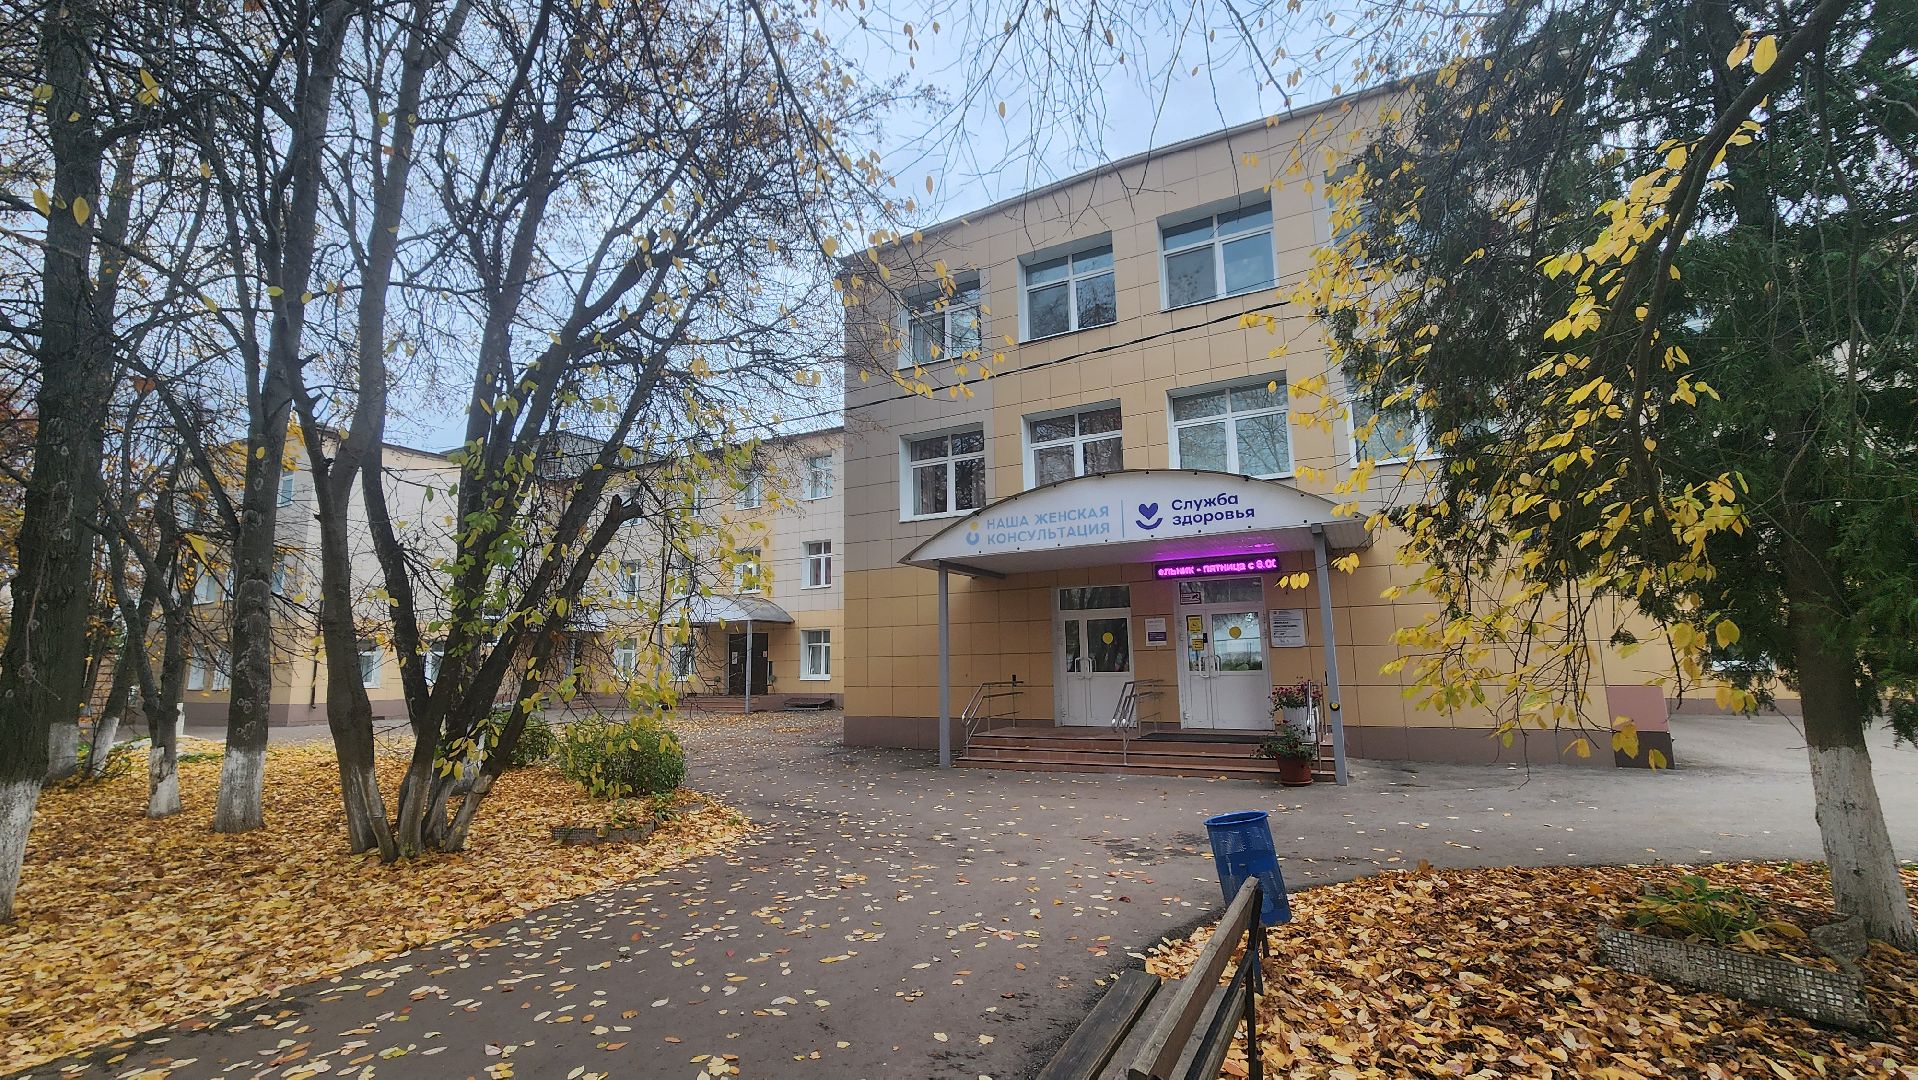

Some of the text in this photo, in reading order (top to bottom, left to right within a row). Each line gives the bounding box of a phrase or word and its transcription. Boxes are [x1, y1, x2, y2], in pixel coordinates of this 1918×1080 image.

[1171, 493, 1239, 511] Служба
[987, 506, 1109, 530] НАША ЖЕНСКАЯ
[1172, 508, 1255, 526] здоровья
[987, 522, 1110, 545] КОНСУЛЬТАЦИЯ
[1203, 563, 1246, 573] пятница
